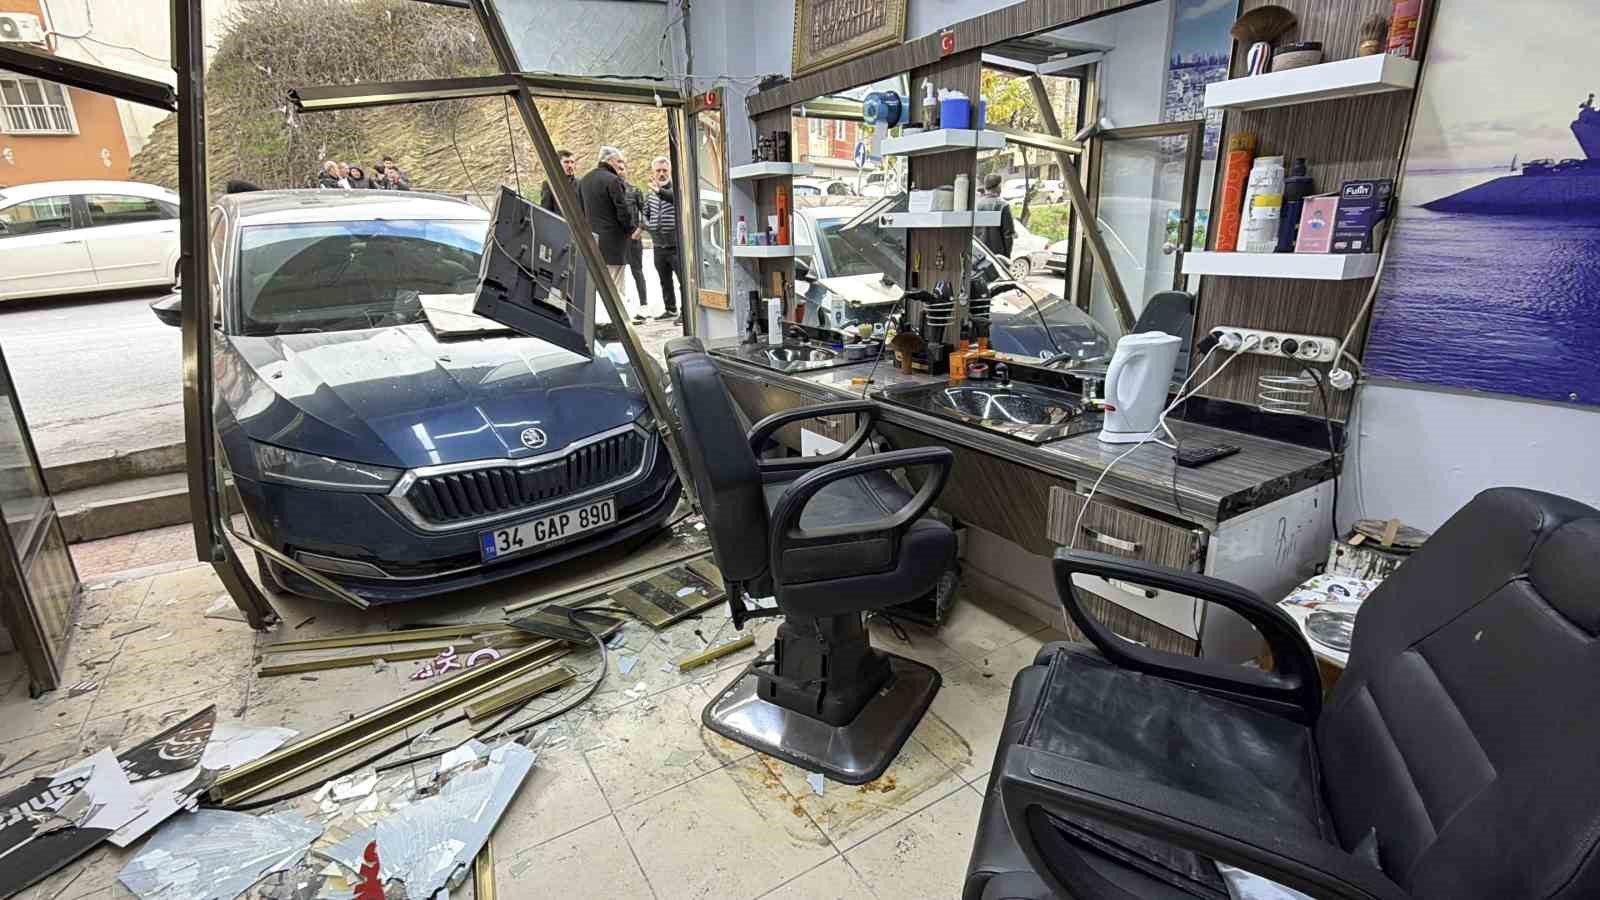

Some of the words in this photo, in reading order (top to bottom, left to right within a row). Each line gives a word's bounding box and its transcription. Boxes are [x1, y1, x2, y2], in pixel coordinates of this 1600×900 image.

[497, 527, 524, 552] 34
[534, 514, 570, 541] GAP
[579, 502, 612, 528] 890
